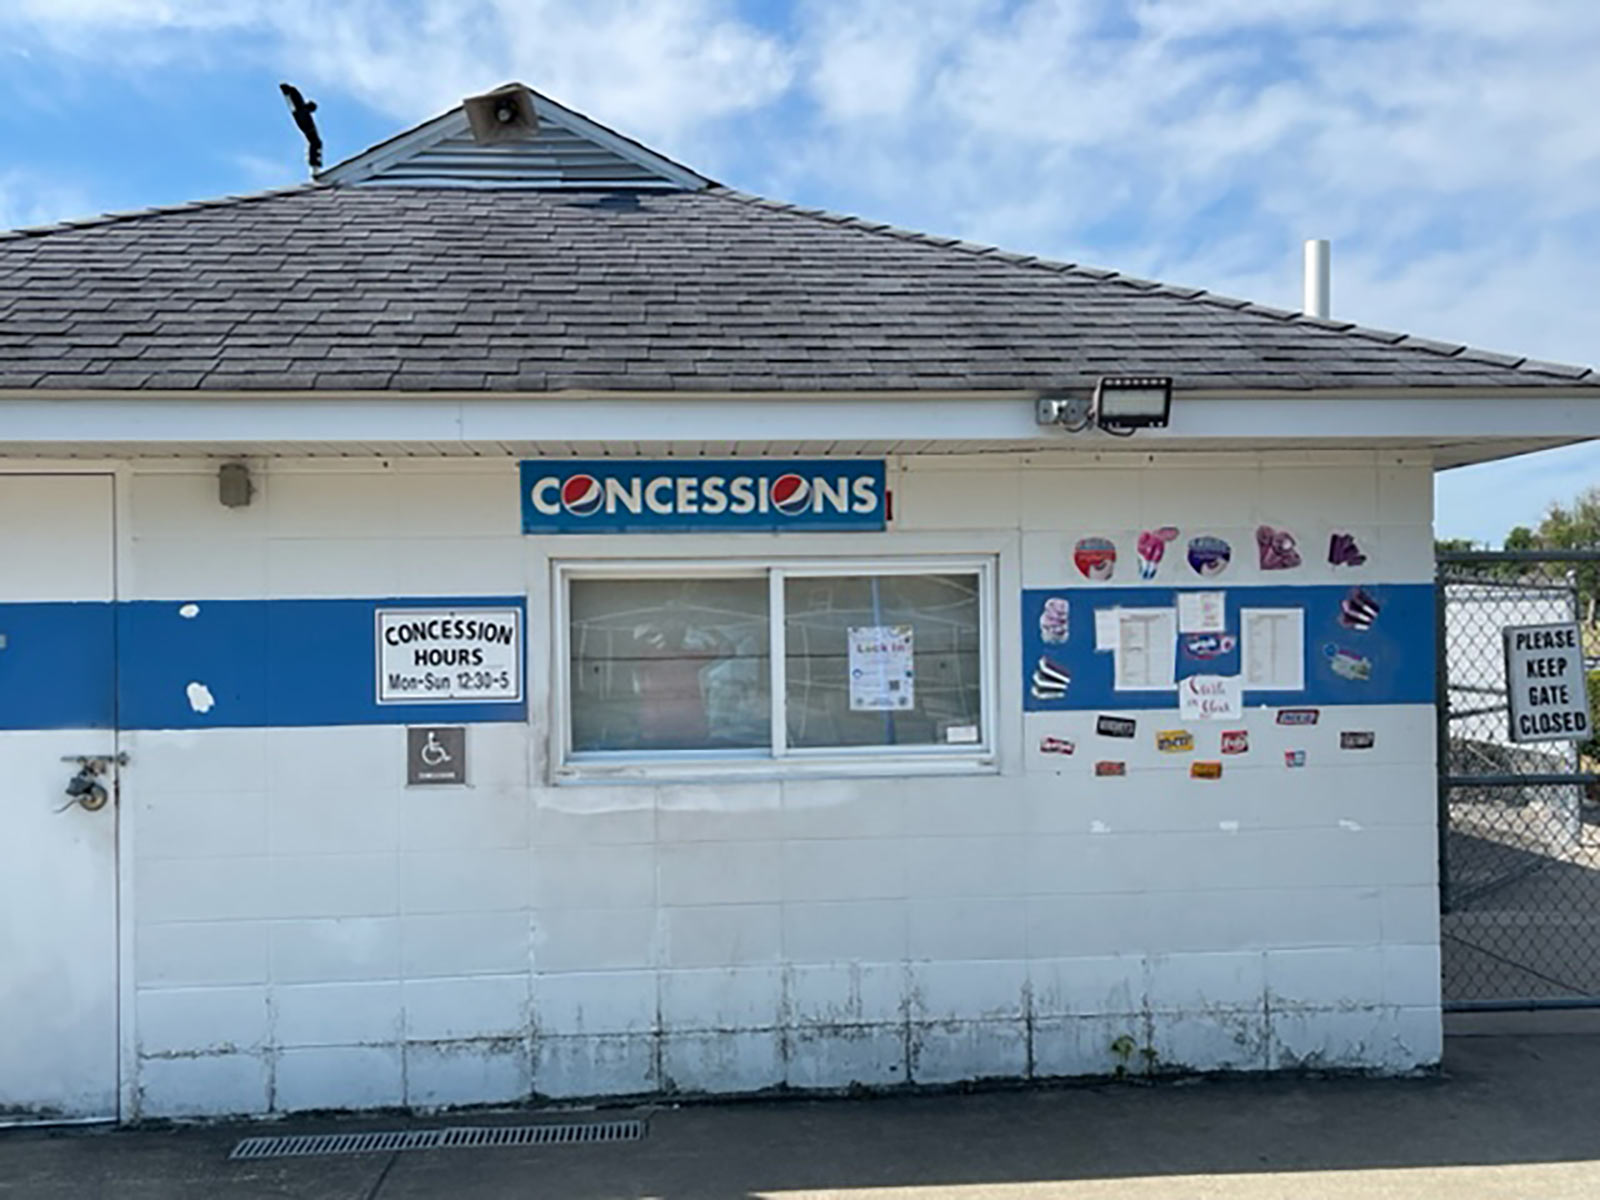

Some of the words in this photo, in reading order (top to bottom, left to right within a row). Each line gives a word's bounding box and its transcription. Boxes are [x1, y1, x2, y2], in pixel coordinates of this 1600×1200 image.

[531, 474, 878, 516] CONCESSIONS
[385, 620, 513, 646] CONCESSION
[1516, 630, 1576, 650] PLEASE
[414, 648, 484, 667] HOURS
[1526, 657, 1568, 678] KEEP
[388, 673, 451, 690] Mon-Sun
[456, 671, 510, 689] 12:30-5
[1528, 685, 1569, 706] GATE
[1519, 712, 1587, 735] CLOSED
